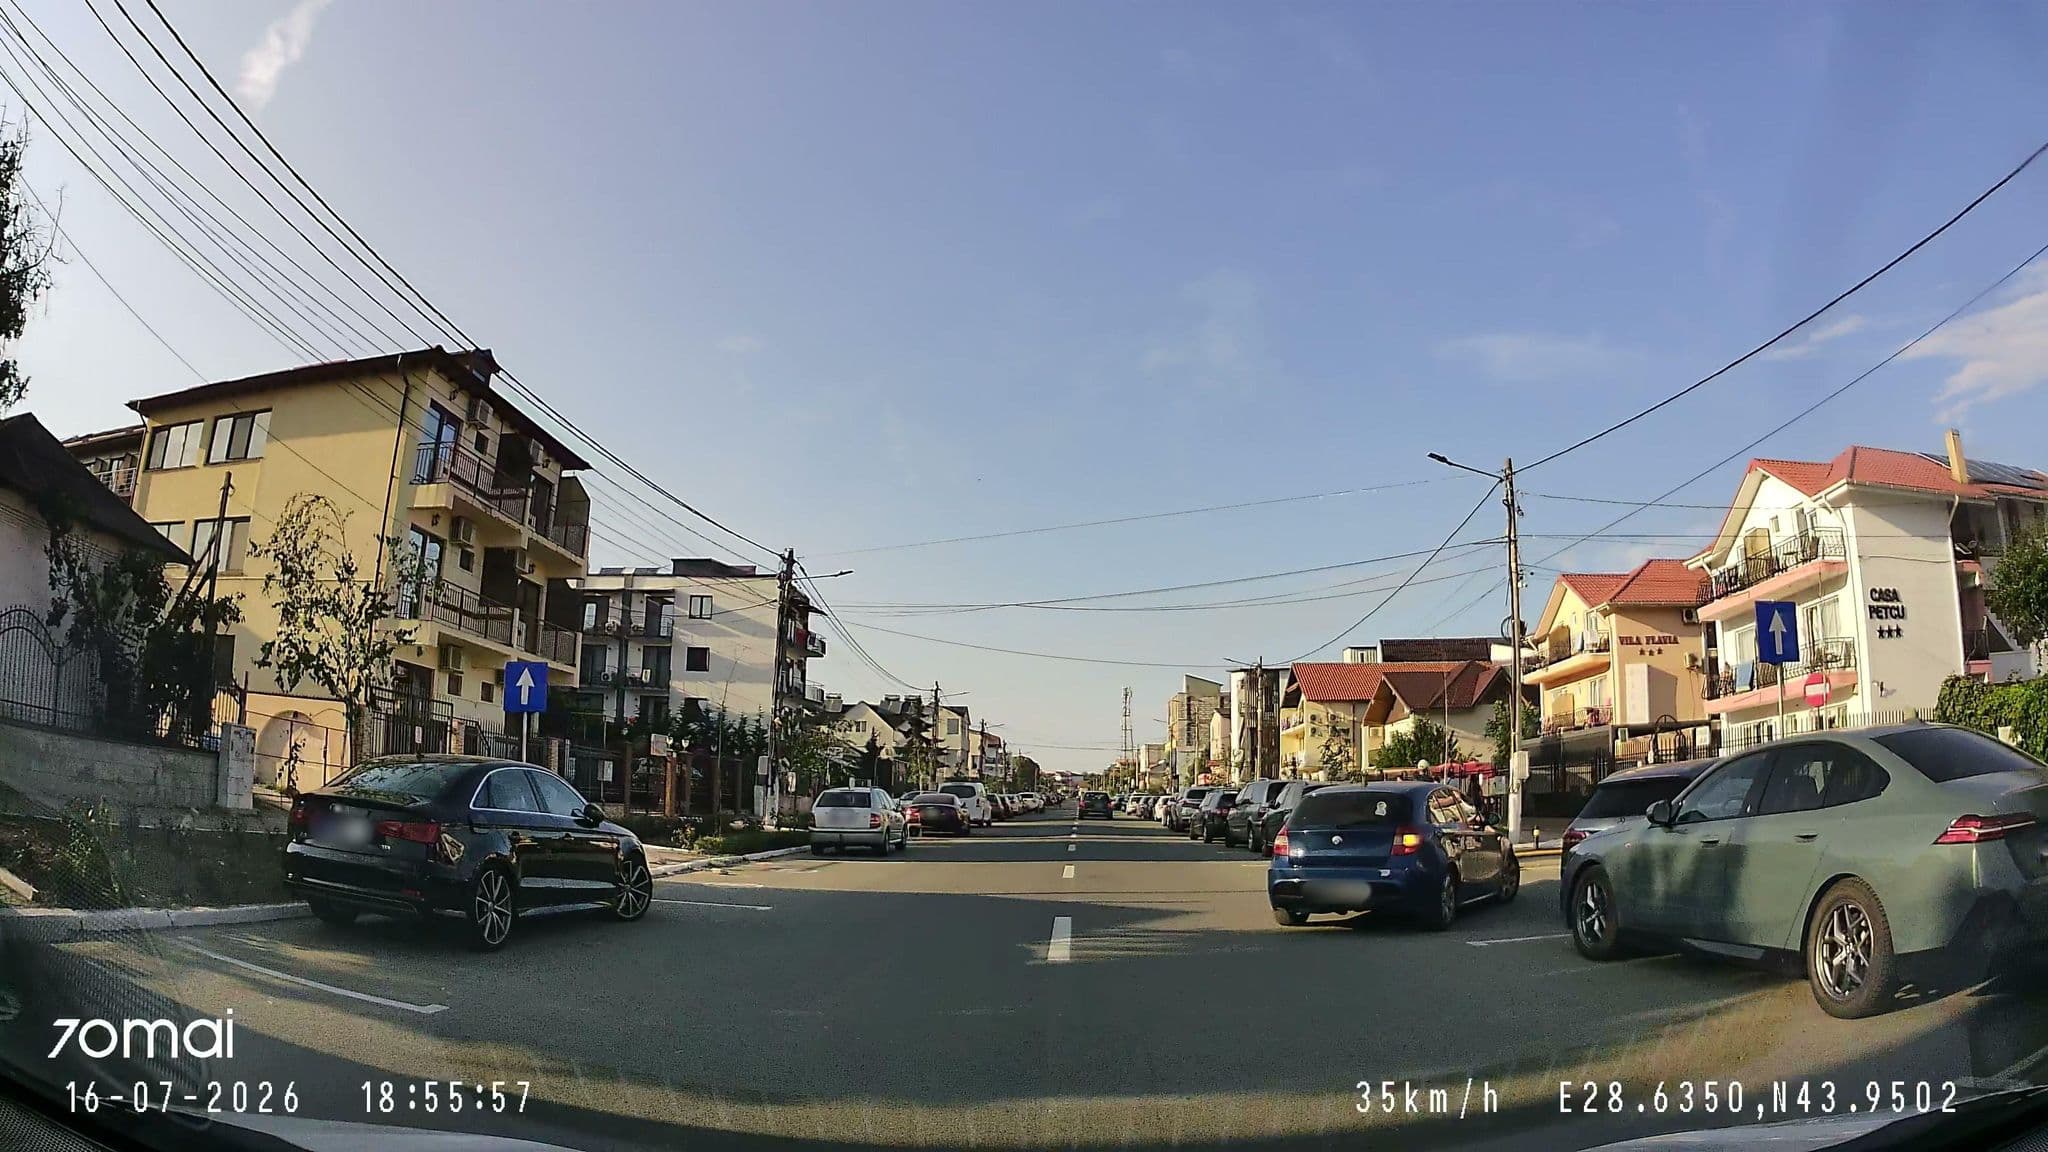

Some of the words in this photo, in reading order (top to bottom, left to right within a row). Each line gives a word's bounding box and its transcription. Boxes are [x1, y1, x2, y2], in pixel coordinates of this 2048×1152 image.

[1870, 587, 1901, 602] CASA
[1868, 605, 1905, 620] PETCU
[1645, 635, 1679, 645] FLAVIA
